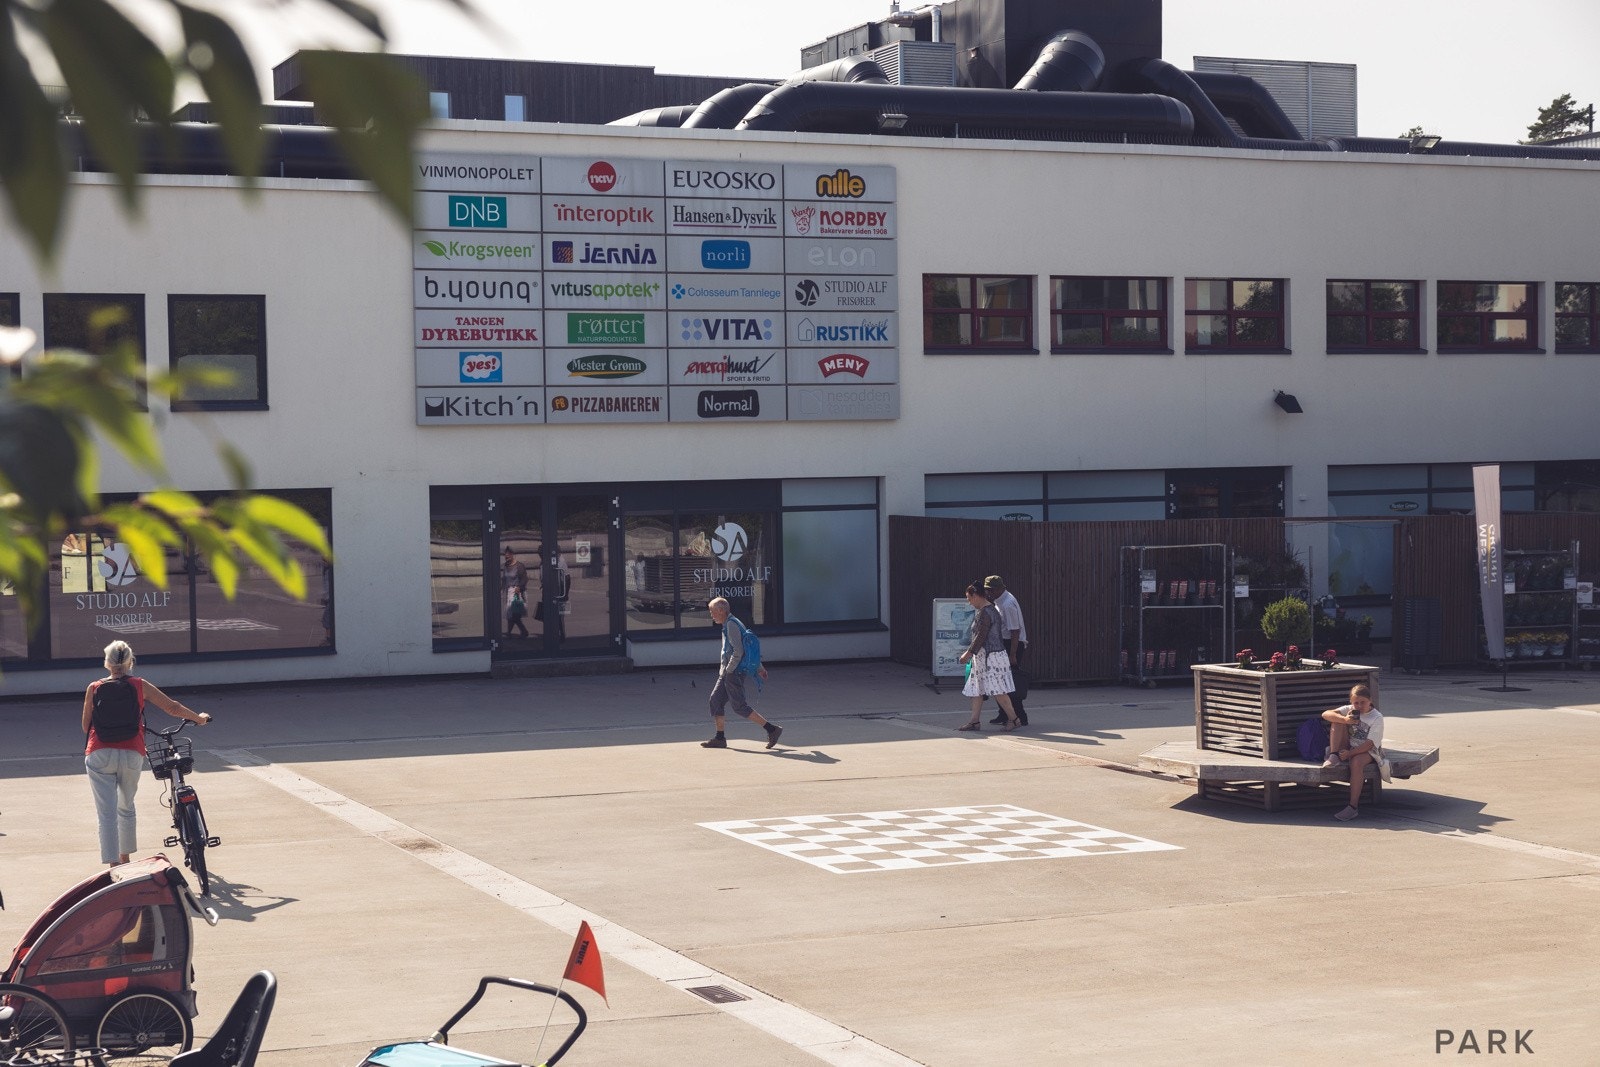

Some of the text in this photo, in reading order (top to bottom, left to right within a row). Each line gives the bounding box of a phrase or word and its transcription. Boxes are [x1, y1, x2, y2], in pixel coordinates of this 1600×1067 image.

[419, 165, 534, 180] VINMONOPOLET
[673, 170, 775, 190] EUROSKO
[816, 169, 865, 198] nille
[455, 196, 500, 228] DNB
[706, 247, 746, 262] norli
[688, 287, 781, 299] Colosseum Tannlege
[824, 280, 888, 293] STUDIO ALF
[837, 296, 876, 306] FRISØRER
[455, 317, 504, 326] TANGEN
[421, 328, 538, 341] DYREBUTIKK
[702, 318, 762, 341] VITA
[816, 326, 888, 341] RUSTIKK
[466, 358, 497, 373] yes!
[572, 359, 642, 371] Mester Grønn
[824, 358, 864, 372] MENY
[571, 396, 660, 413] PIZZABAKEREN
[704, 395, 753, 412] Normal
[693, 566, 772, 584] STUDIO ALF
[76, 591, 171, 610] STUDIO ALF
